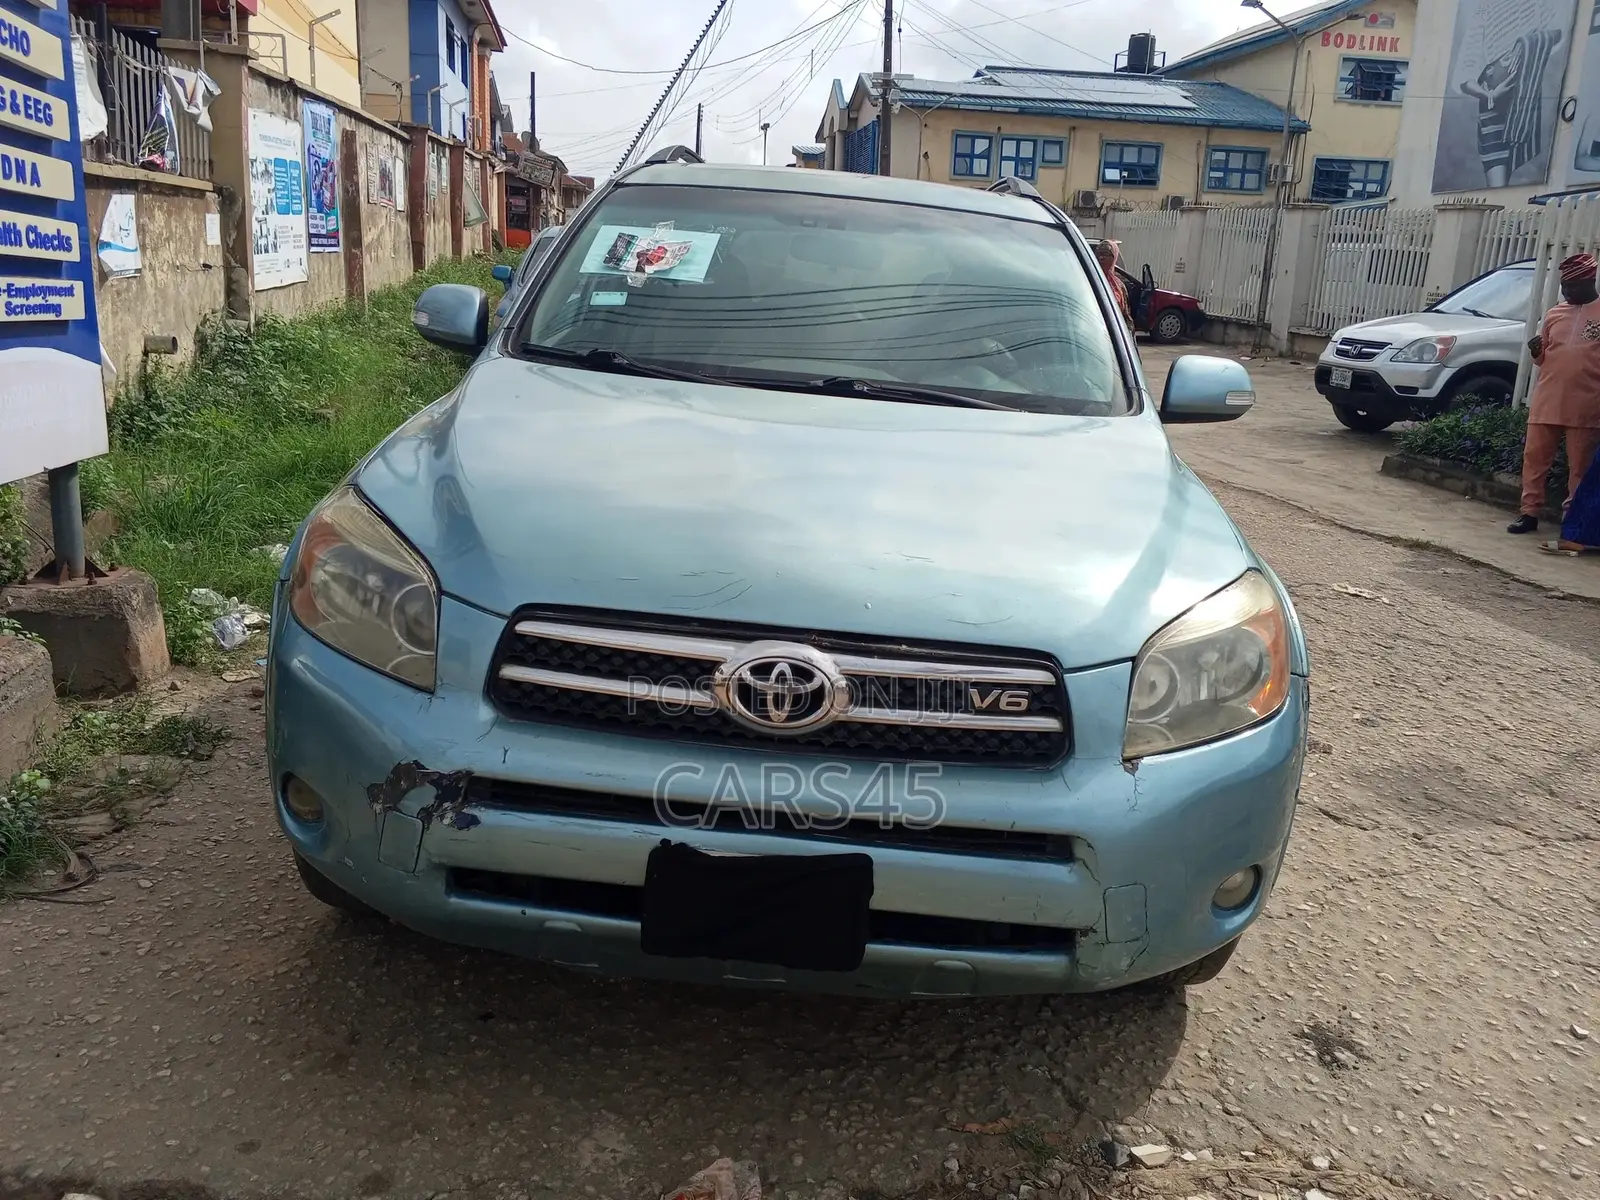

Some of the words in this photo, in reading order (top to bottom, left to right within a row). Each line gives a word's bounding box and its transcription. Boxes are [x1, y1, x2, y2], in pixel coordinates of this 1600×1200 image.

[0, 17, 31, 57] CHO
[1321, 31, 1400, 52] BODLINK
[10, 89, 21, 116] &
[22, 93, 54, 127] EEG
[1, 154, 41, 188] DNA
[26, 224, 73, 253] Checks
[0, 283, 75, 300] -Employment
[5, 300, 62, 318] Screening
[968, 687, 1031, 712] V6
